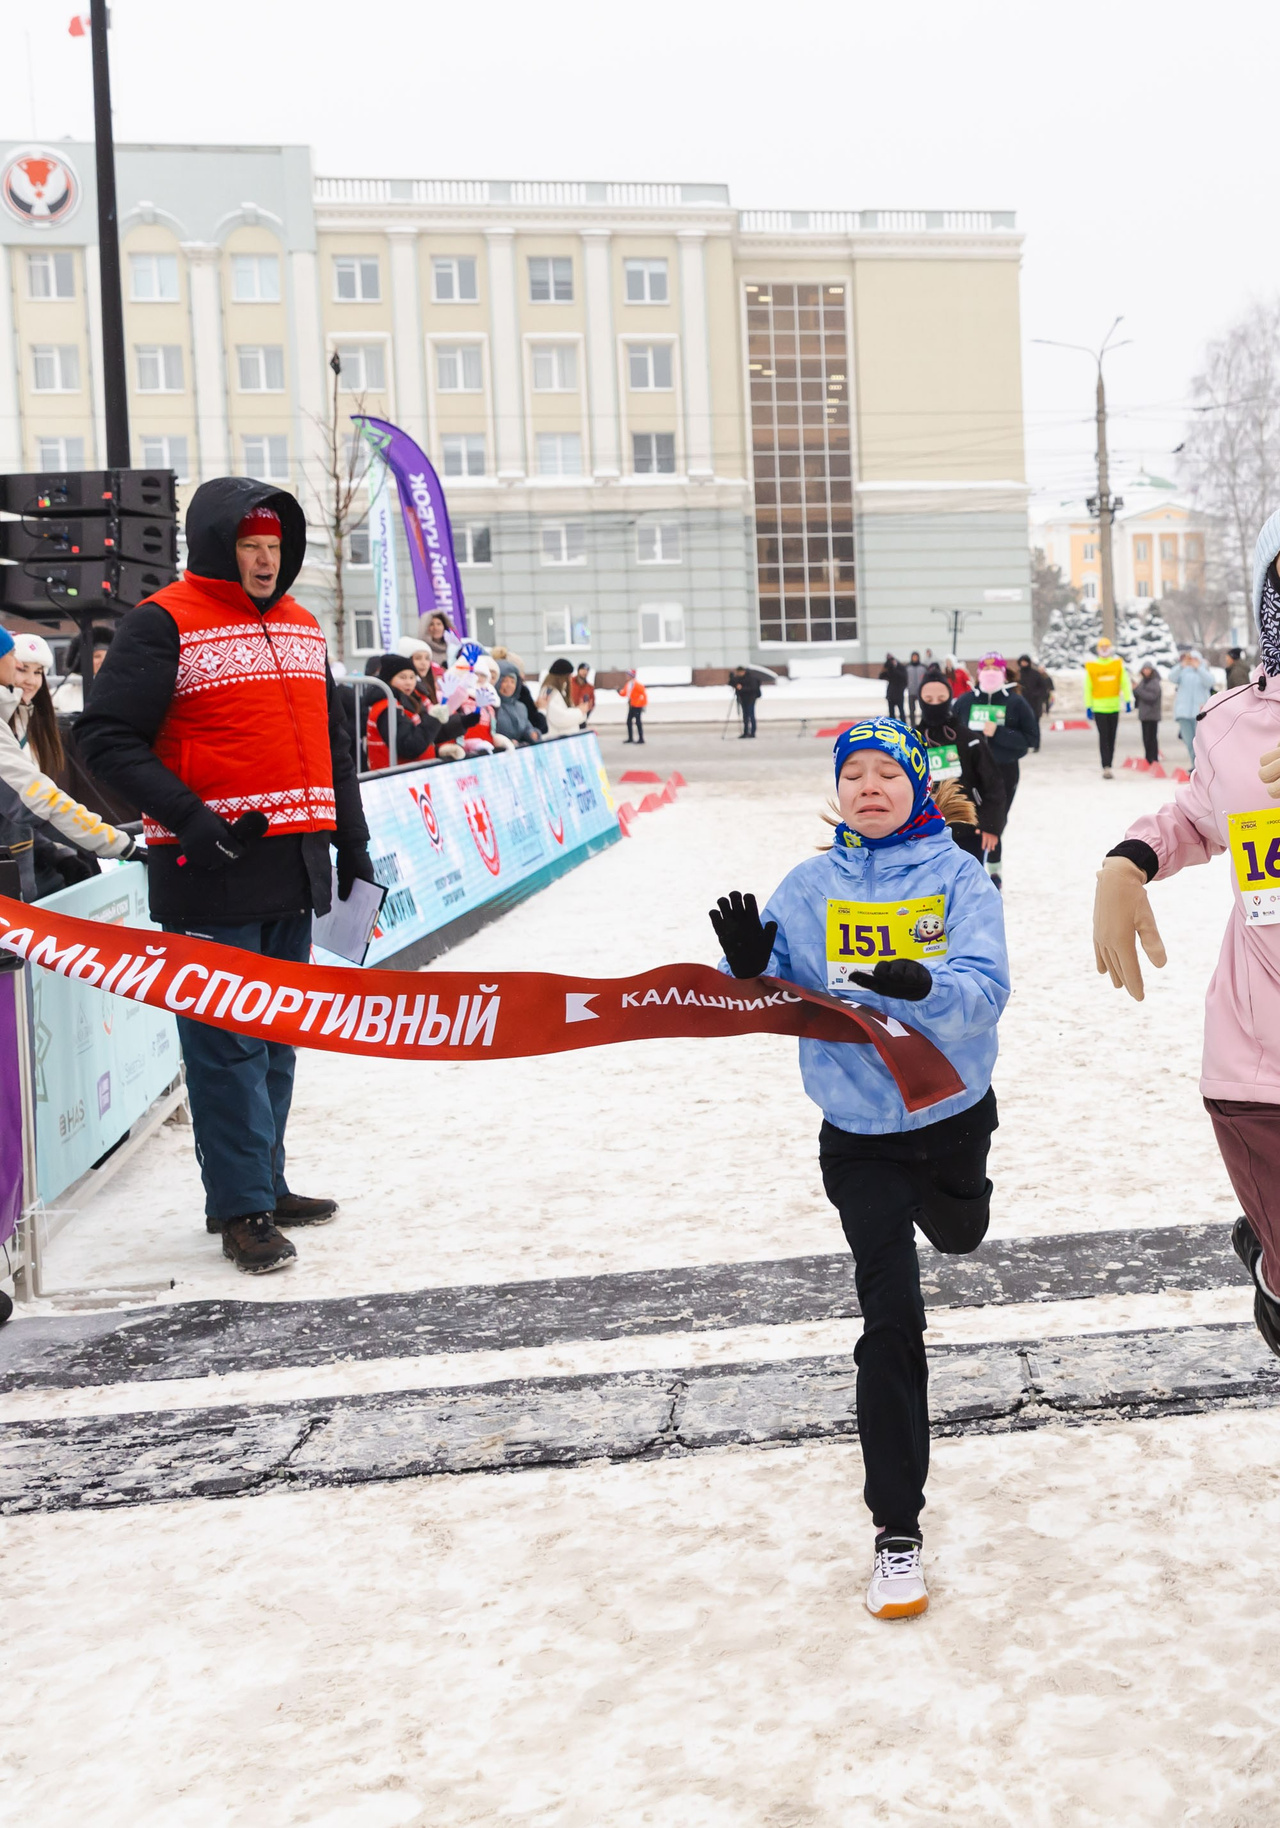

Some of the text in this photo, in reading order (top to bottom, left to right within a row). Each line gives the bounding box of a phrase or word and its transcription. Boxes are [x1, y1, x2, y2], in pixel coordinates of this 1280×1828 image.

[972, 710, 990, 721] 911
[839, 923, 896, 957] 151
[164, 962, 502, 1047] СПОРТИВНЫЙ
